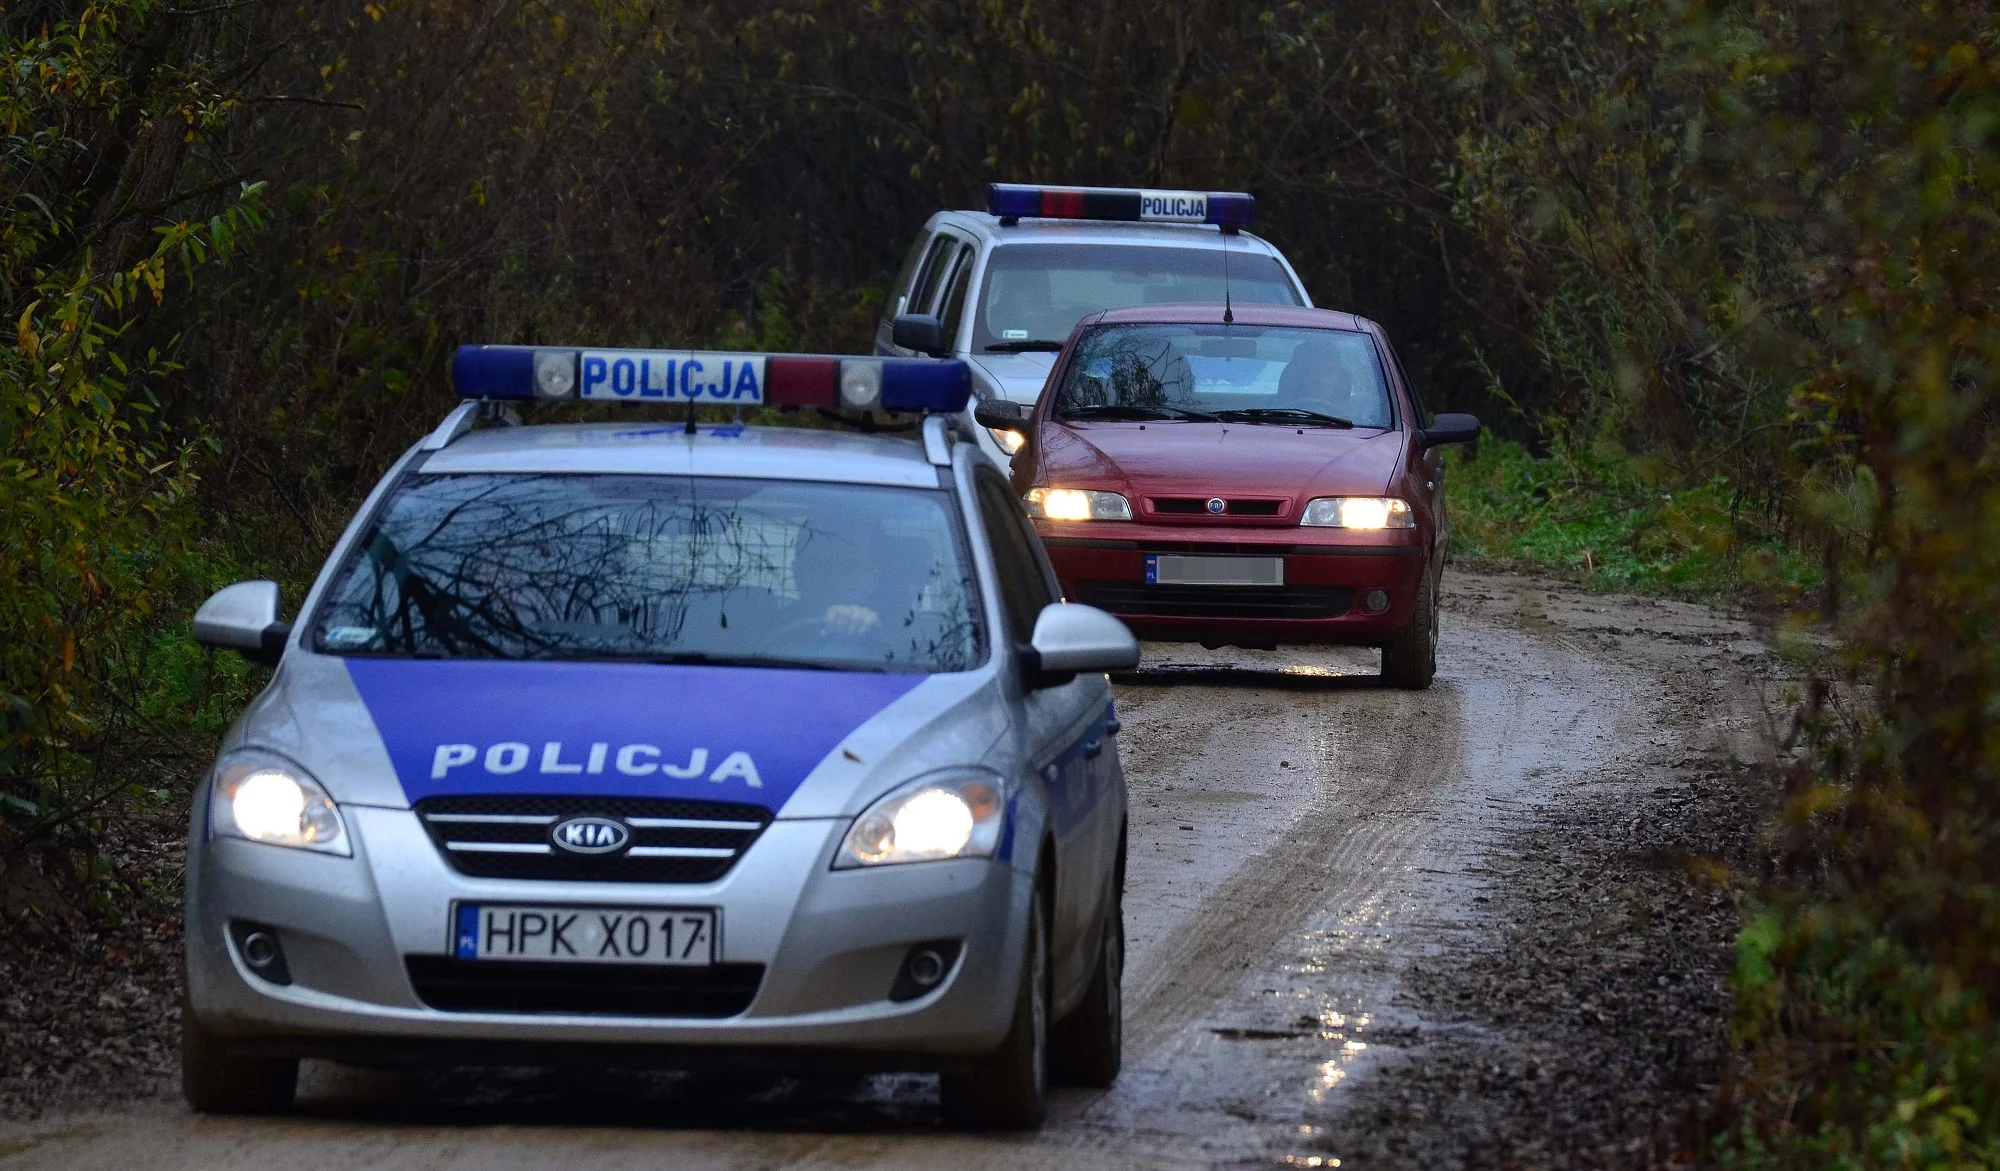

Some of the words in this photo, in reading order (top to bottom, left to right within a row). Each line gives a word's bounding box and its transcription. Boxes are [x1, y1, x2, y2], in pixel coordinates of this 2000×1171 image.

[1142, 198, 1205, 216] POLICJA
[583, 356, 761, 400] POLICJA
[430, 742, 763, 789] POLICJA
[566, 824, 616, 846] KIA
[460, 935, 475, 950] PL
[486, 912, 578, 956] HPK
[598, 914, 705, 959] X017
